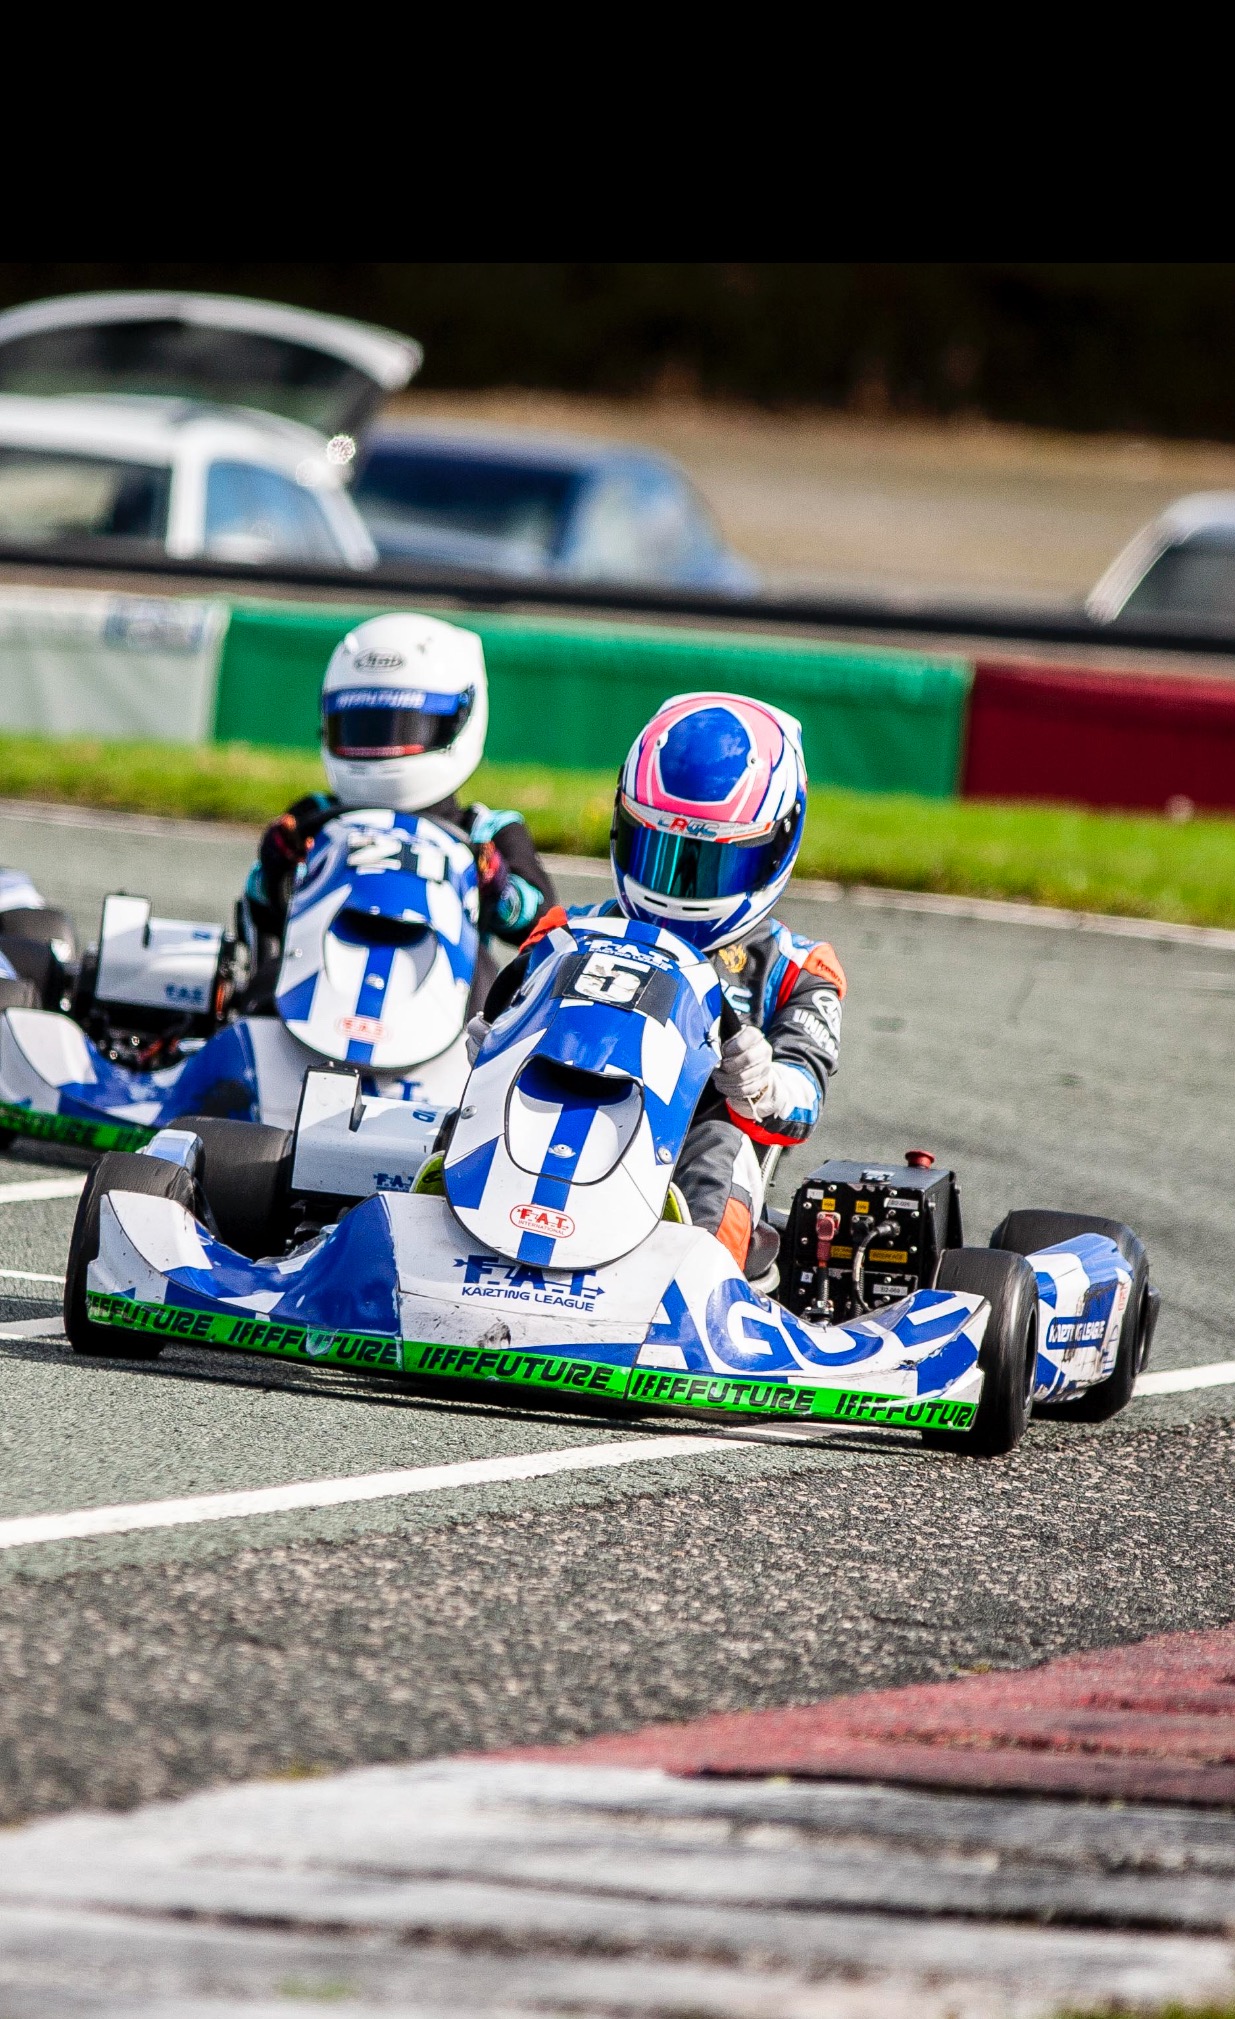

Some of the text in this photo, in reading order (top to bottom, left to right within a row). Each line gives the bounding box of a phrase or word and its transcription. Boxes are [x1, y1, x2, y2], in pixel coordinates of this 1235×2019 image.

[347, 831, 446, 882] 21
[518, 1219, 565, 1236] INTERNATIONAL
[462, 1286, 595, 1312] KARTING LEAGUE
